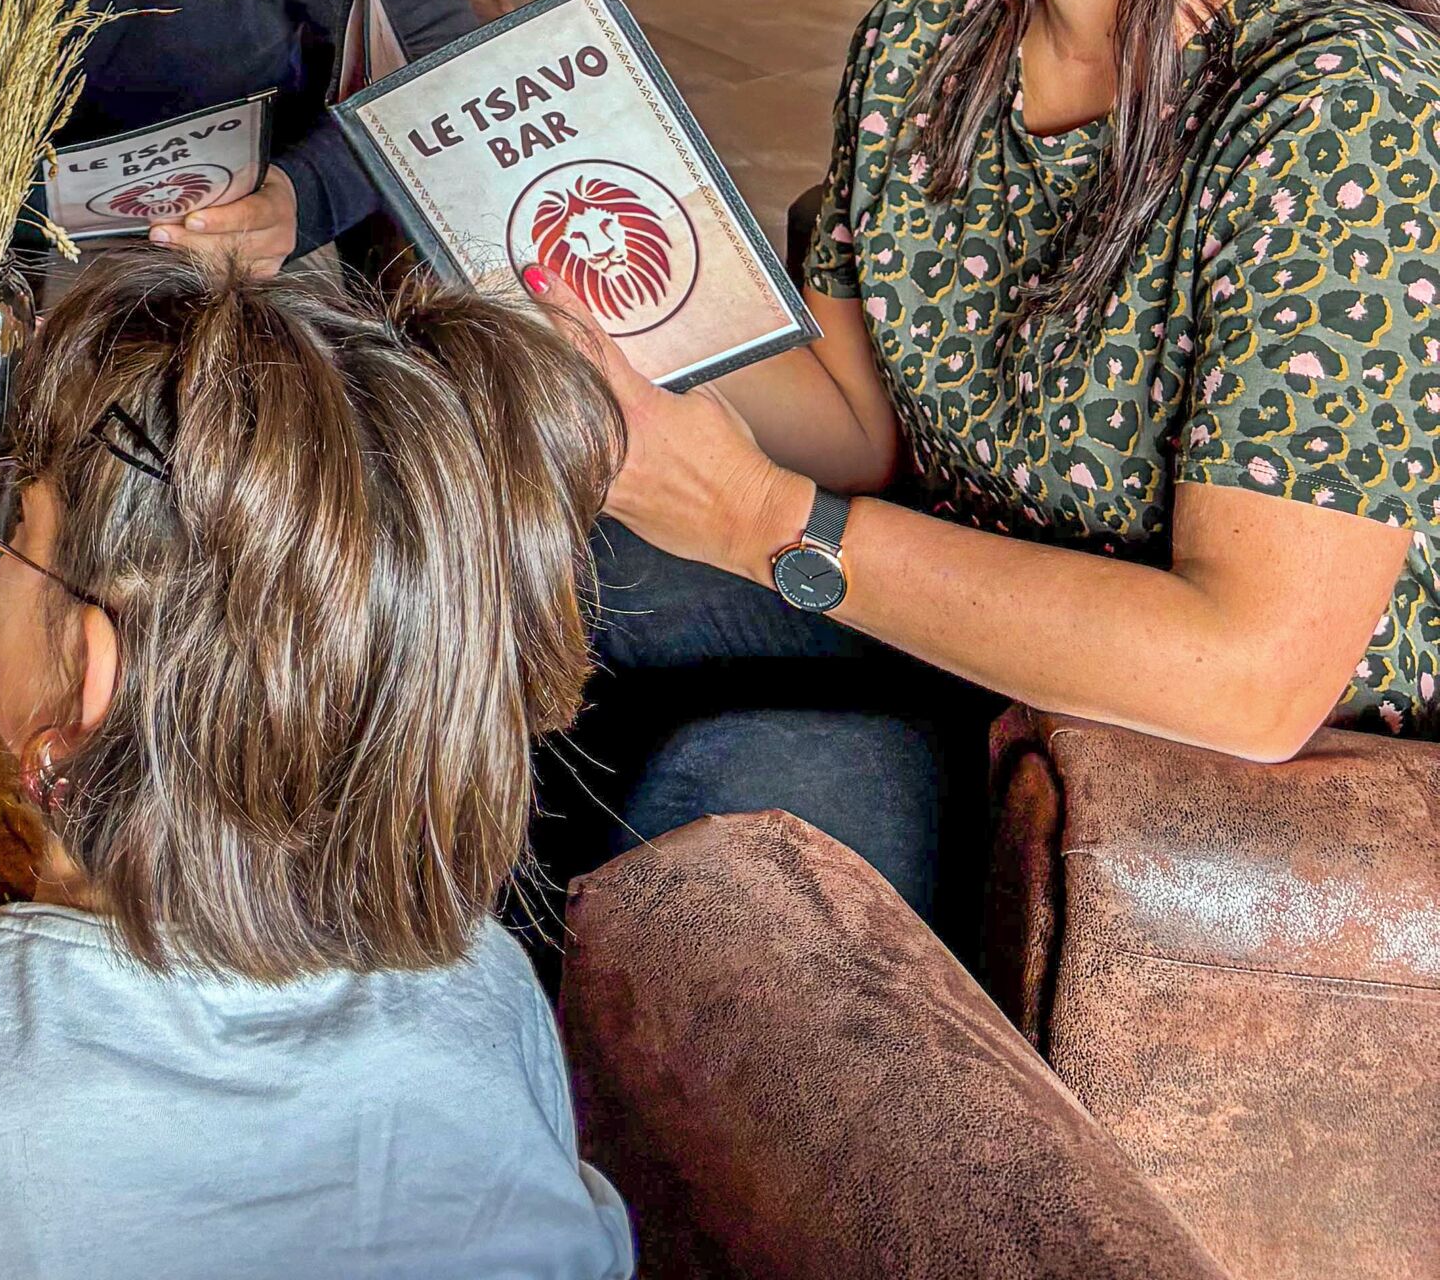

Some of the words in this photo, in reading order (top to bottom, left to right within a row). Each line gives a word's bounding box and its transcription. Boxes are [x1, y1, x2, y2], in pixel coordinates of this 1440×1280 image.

[408, 112, 464, 158] LE
[461, 44, 609, 133] TSAVO
[68, 157, 109, 173] LE
[117, 118, 242, 164] TSAVO
[122, 148, 192, 177] BAR
[486, 110, 579, 169] BAR
